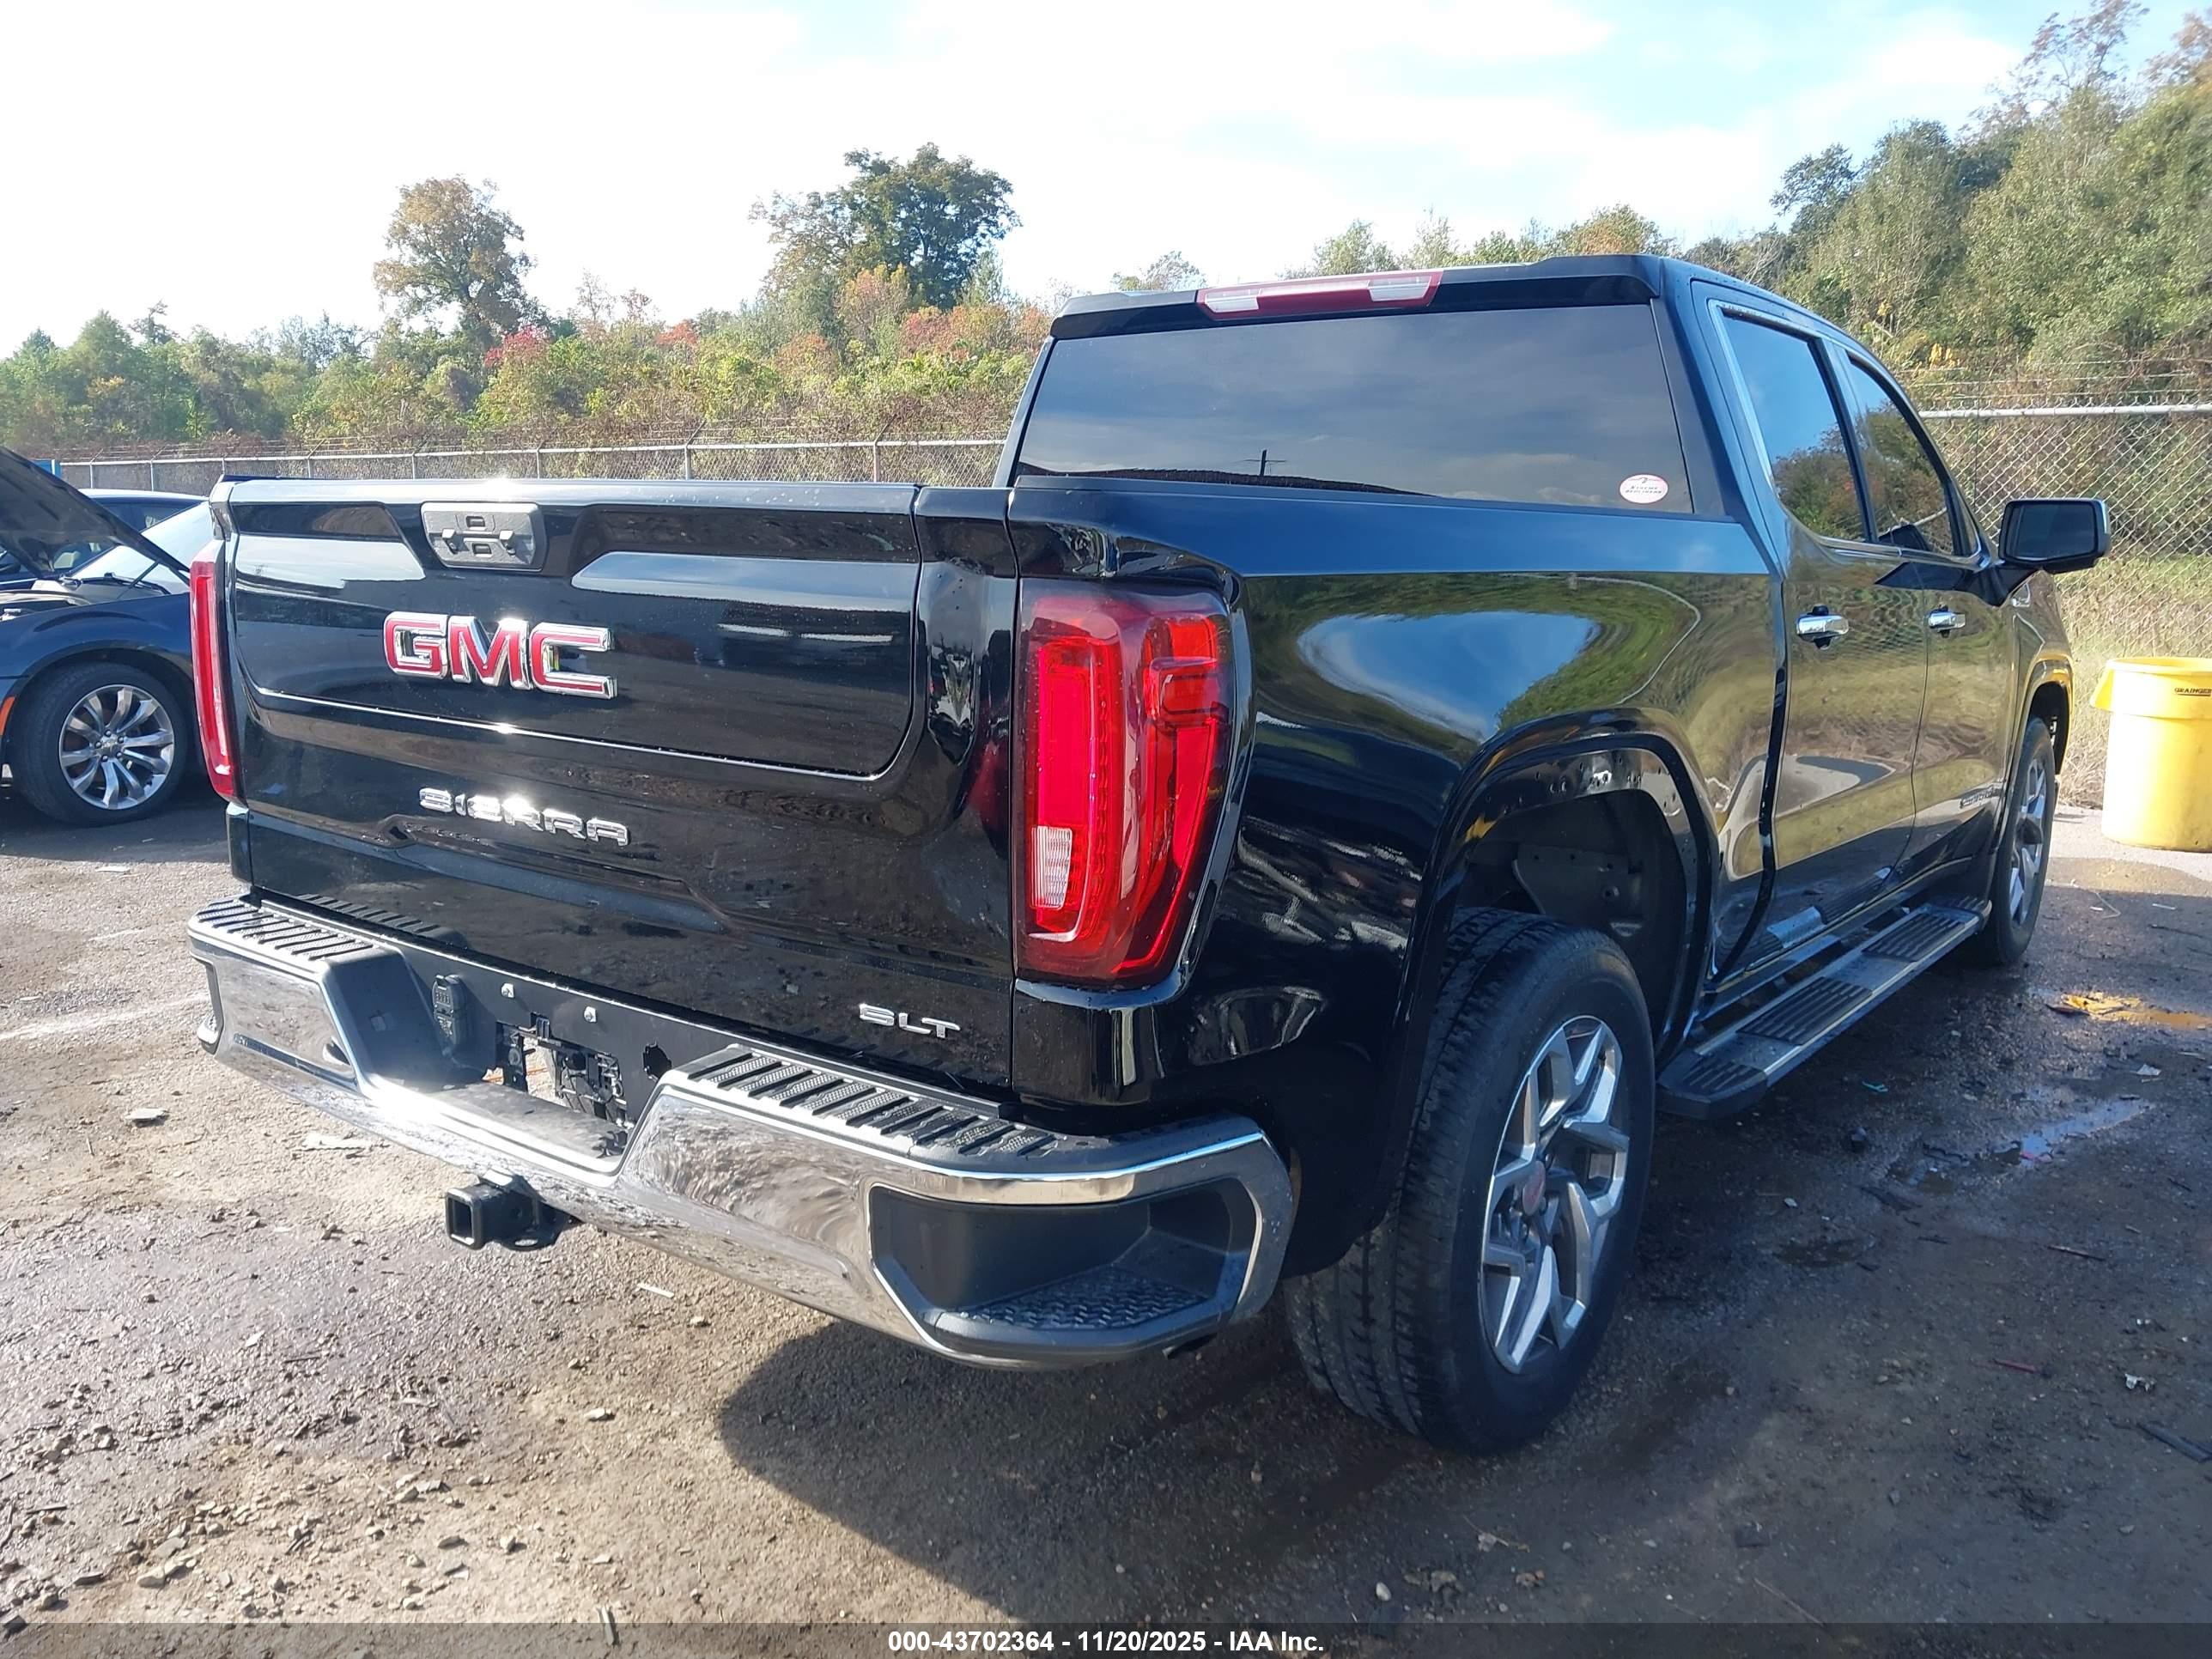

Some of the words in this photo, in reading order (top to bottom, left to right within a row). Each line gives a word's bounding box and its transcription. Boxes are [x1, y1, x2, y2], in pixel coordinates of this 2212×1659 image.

[384, 611, 618, 700] GMC
[419, 787, 630, 847] SIERRA
[859, 1003, 961, 1039] SLT
